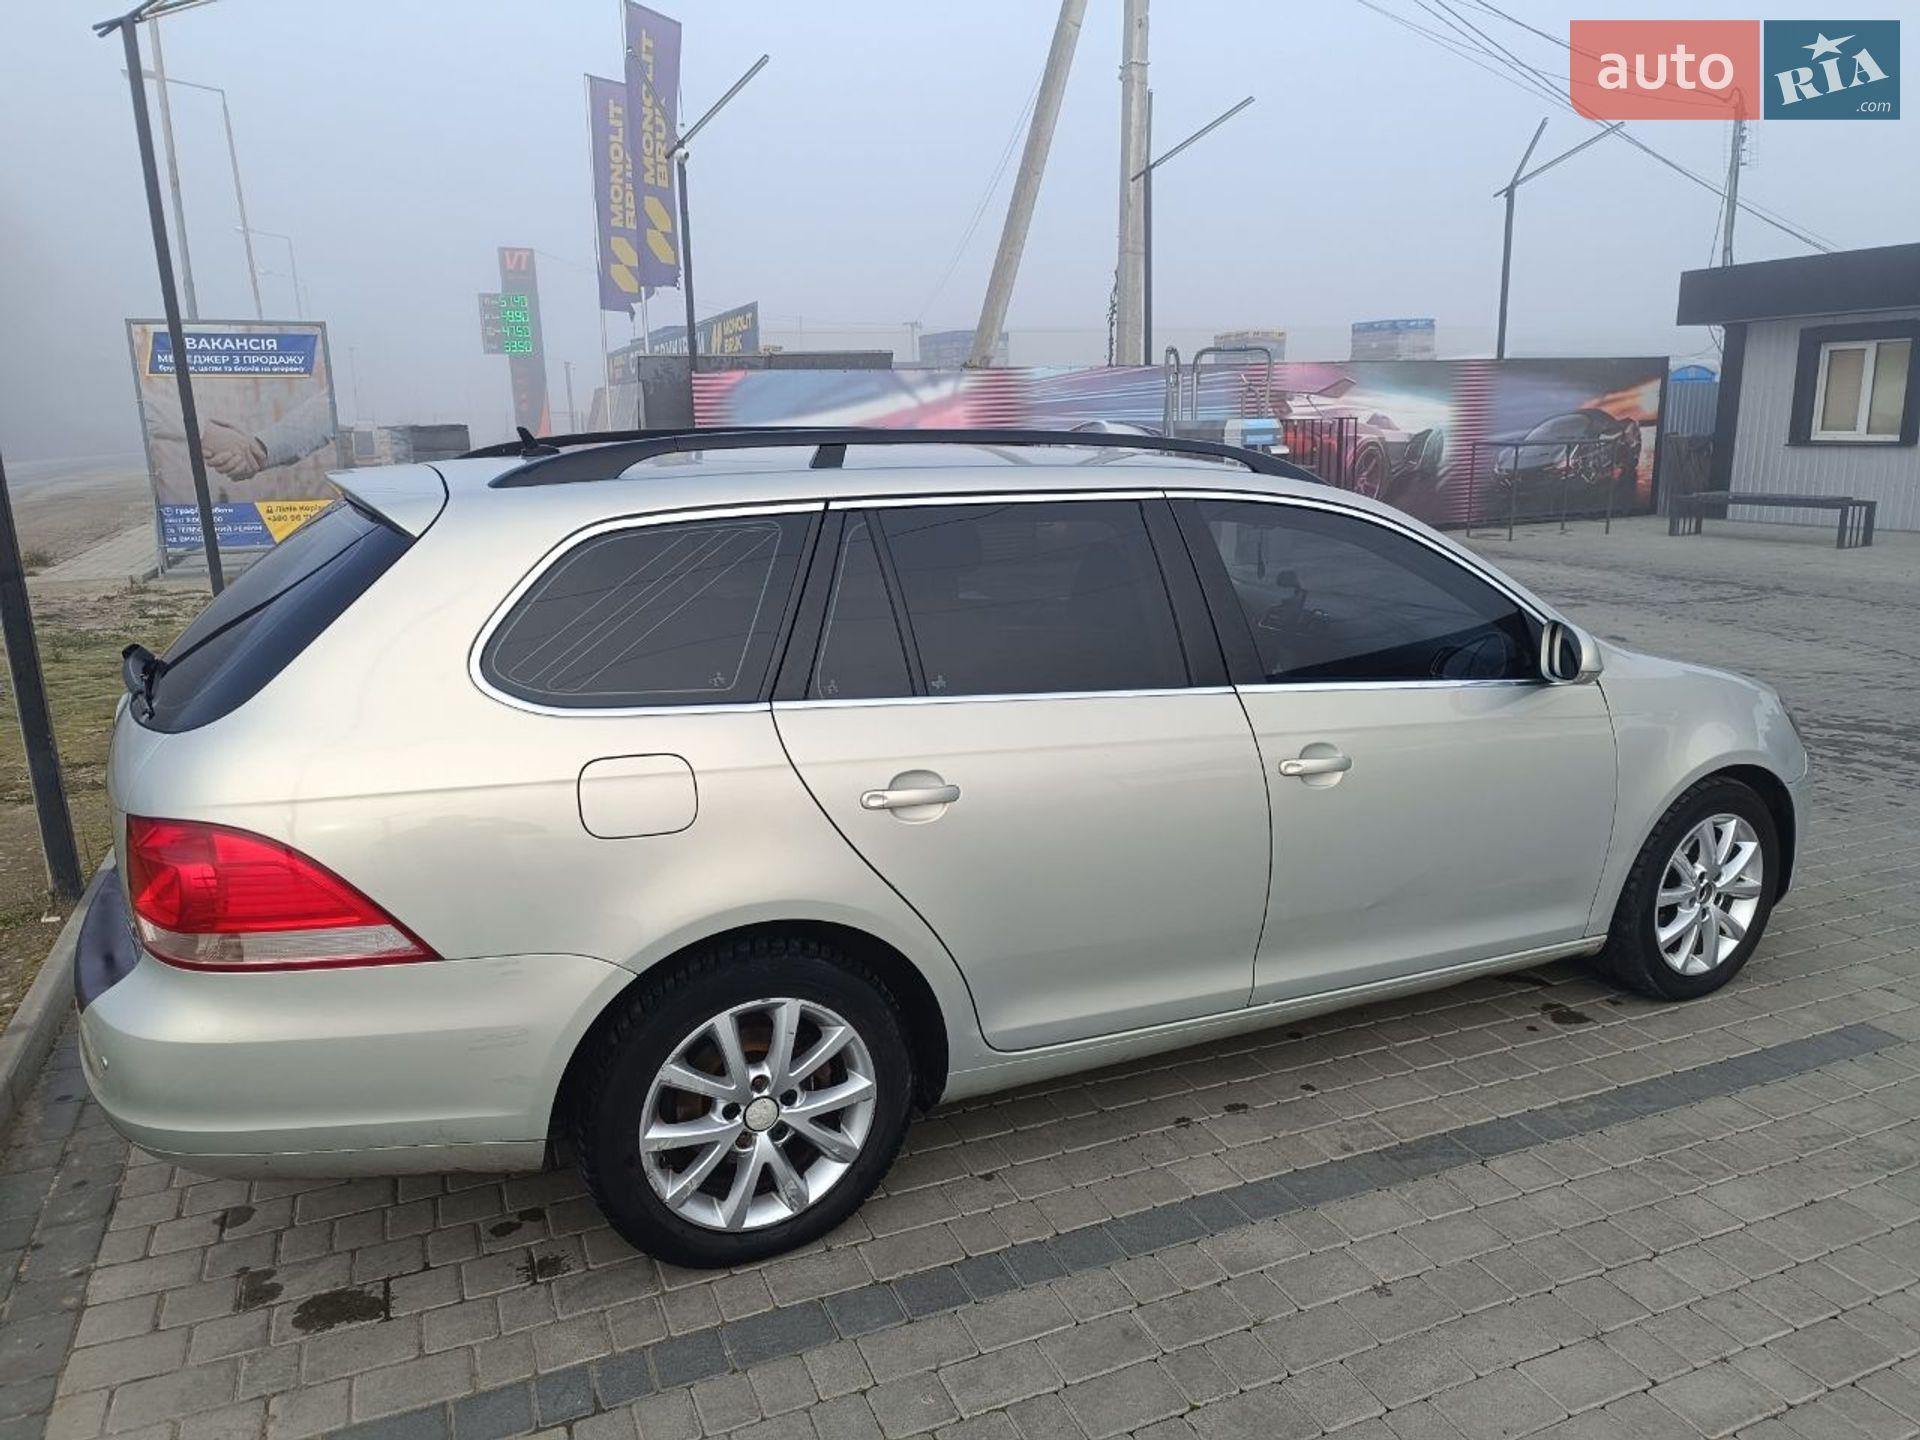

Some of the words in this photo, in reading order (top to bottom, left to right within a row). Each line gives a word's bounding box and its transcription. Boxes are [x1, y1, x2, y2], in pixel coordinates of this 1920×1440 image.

[609, 99, 624, 227] MONOLIT
[504, 251, 529, 271] VT
[184, 337, 278, 350] ВАКАНСІЯ
[243, 355, 305, 365] ПРОДАЖУ
